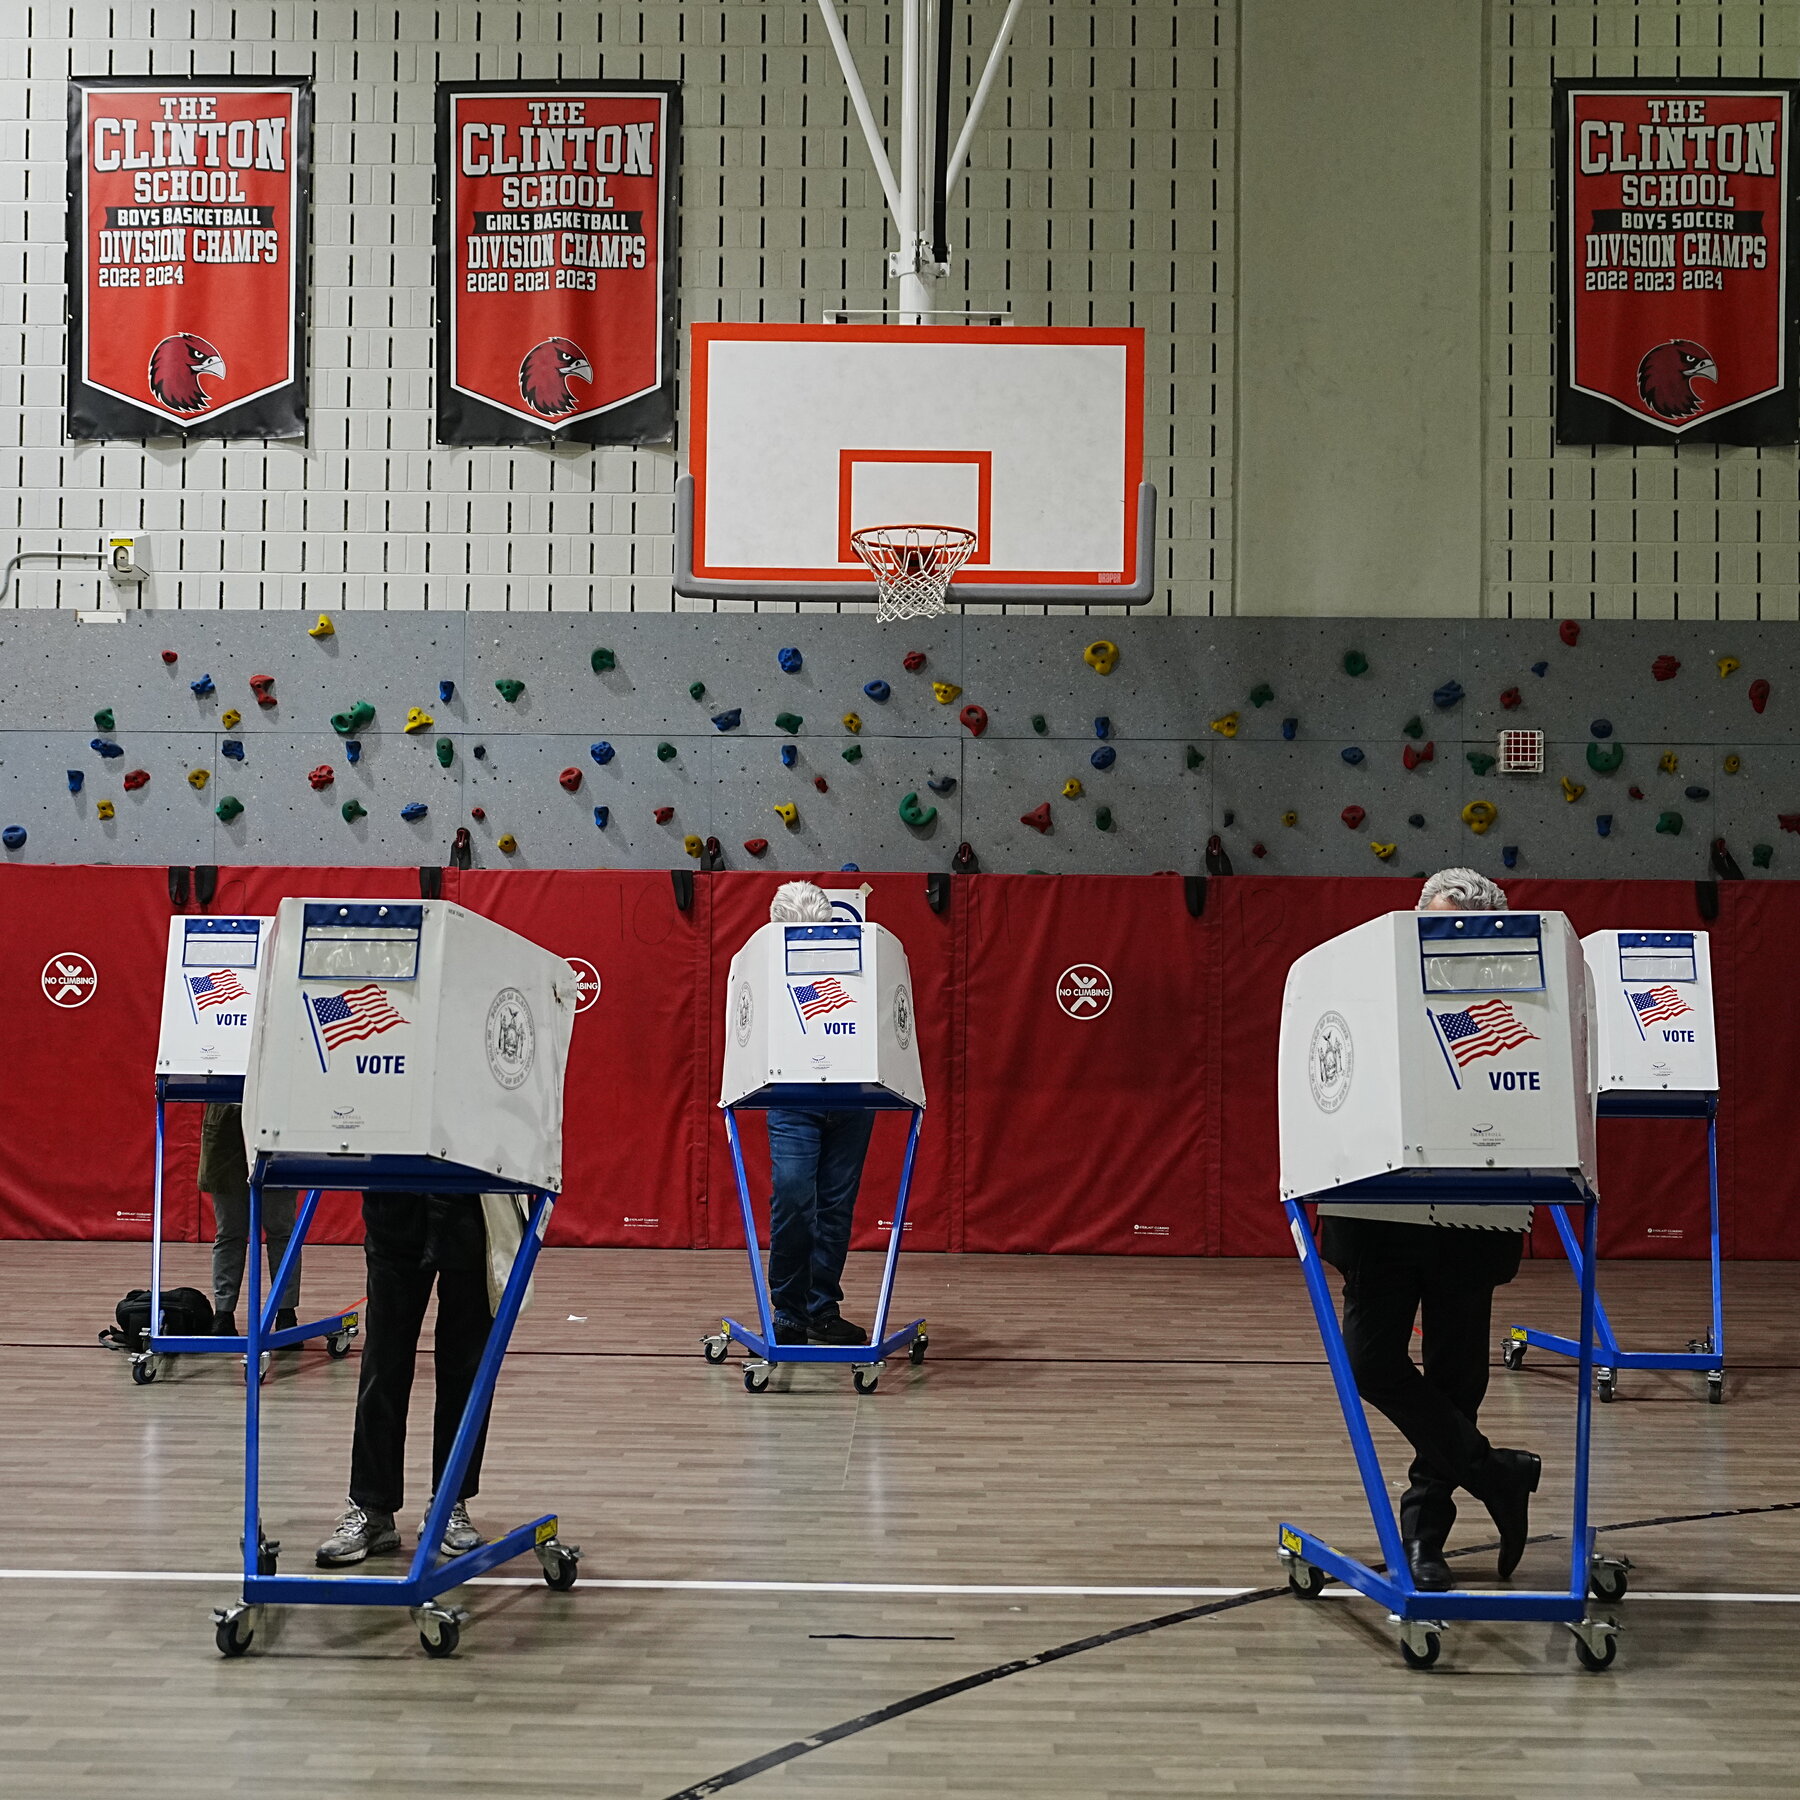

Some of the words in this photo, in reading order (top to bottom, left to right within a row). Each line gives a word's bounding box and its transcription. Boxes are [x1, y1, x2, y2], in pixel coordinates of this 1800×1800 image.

[160, 97, 216, 120] THE
[529, 102, 584, 125] THE
[1648, 101, 1704, 122] THE
[94, 117, 286, 172] CLINTON
[463, 123, 653, 176] CLINTON
[1581, 120, 1775, 175] CLINTON
[135, 170, 245, 203] SCHOOL
[503, 175, 613, 207] SCHOOL
[1623, 175, 1733, 206] SCHOOL
[118, 209, 159, 226] BOYS
[163, 207, 261, 225] BASKETBALL
[487, 214, 529, 231] GIRLS
[534, 212, 628, 231] BASKETBALL
[1622, 213, 1666, 229] BOYS
[1672, 212, 1733, 229] SOCCER
[100, 228, 185, 263] DIVISION
[193, 230, 277, 263] CHAMPS
[468, 234, 554, 268] DIVISION
[562, 233, 645, 268] CHAMPS
[1586, 234, 1675, 267] DIVISION
[1684, 233, 1766, 268] CHAMPS
[99, 268, 140, 287] 2022
[146, 266, 184, 286] 2024
[467, 272, 507, 292] 2020
[515, 271, 550, 291] 2021
[556, 270, 596, 291] 2023
[1586, 271, 1628, 290] 2022
[1634, 272, 1675, 291] 2023
[1683, 270, 1722, 290] 2024
[216, 1013, 247, 1026] VOTE
[823, 1022, 856, 1035] VOTE
[1663, 1030, 1695, 1043] VOTE
[356, 1055, 405, 1075] VOTE
[1489, 1071, 1540, 1091] VOTE
